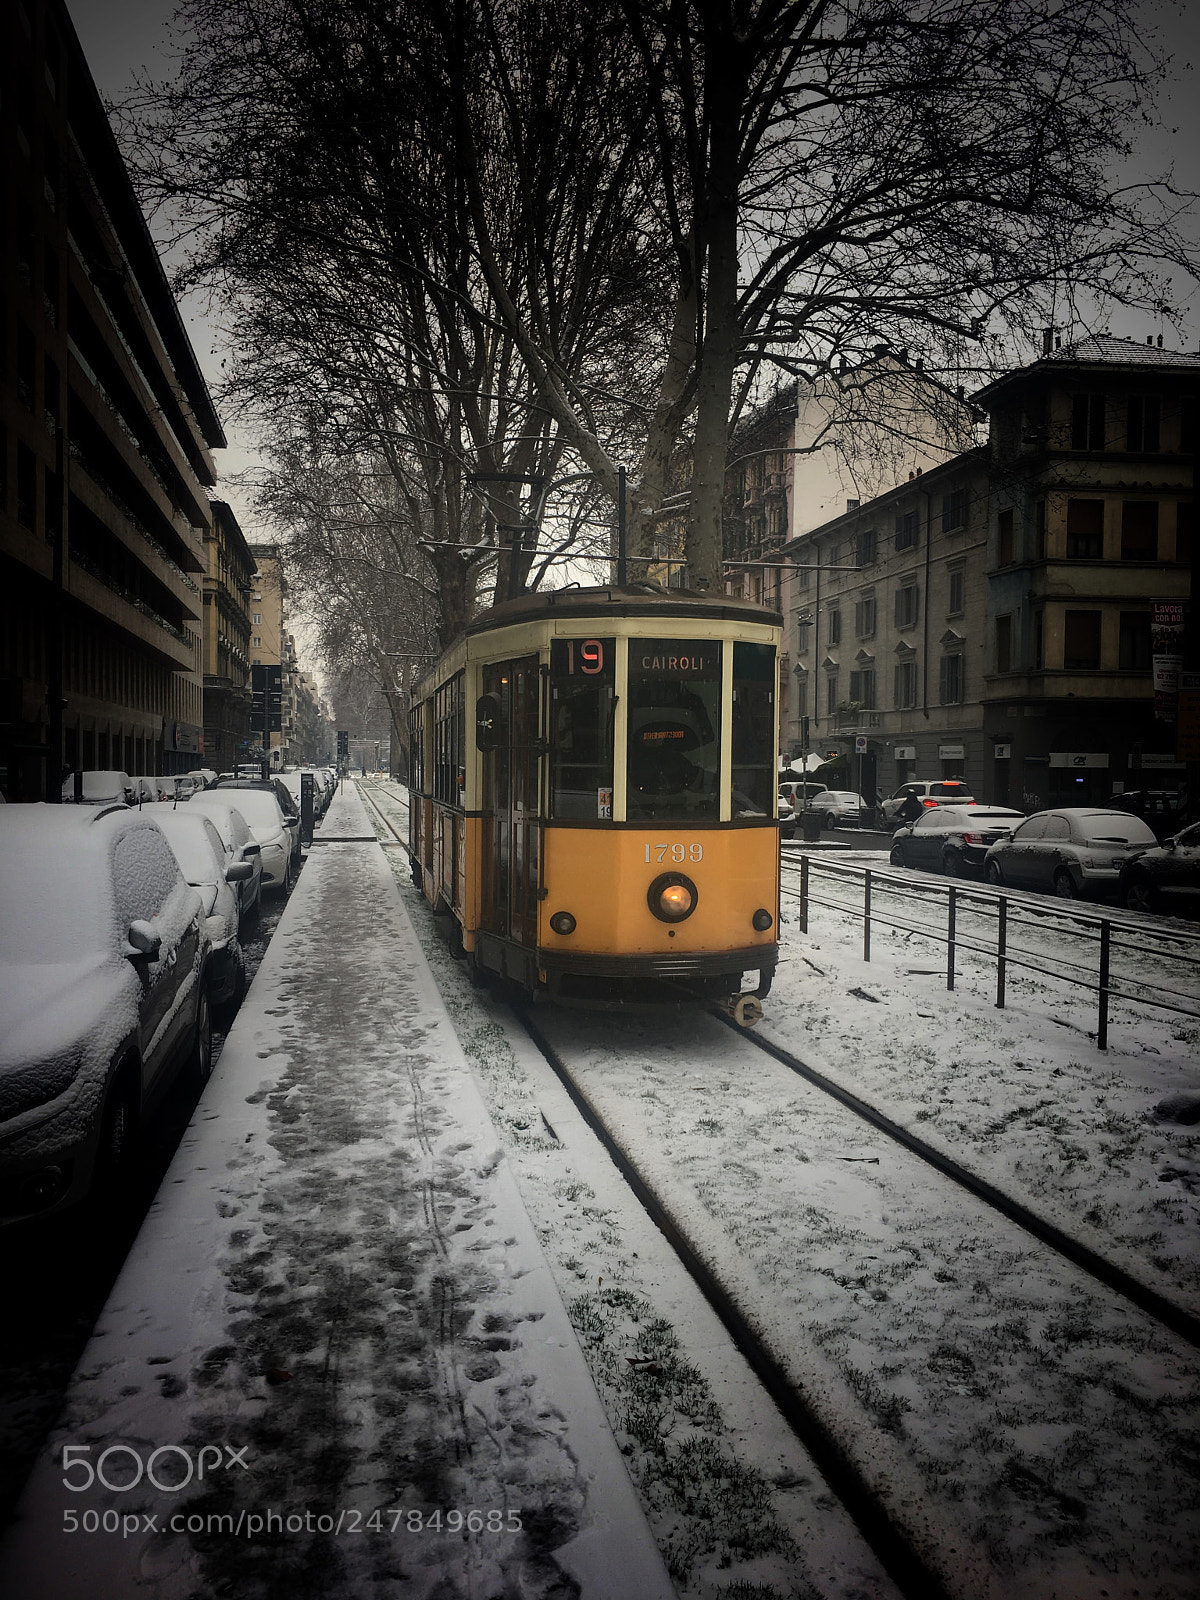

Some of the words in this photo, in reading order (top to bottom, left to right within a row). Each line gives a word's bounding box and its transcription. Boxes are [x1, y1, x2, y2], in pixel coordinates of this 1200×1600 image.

[1154, 603, 1183, 613] Lavora
[1155, 614, 1169, 622] con
[567, 639, 604, 675] 19
[642, 656, 704, 670] CAIROLI
[644, 843, 704, 863] 1799
